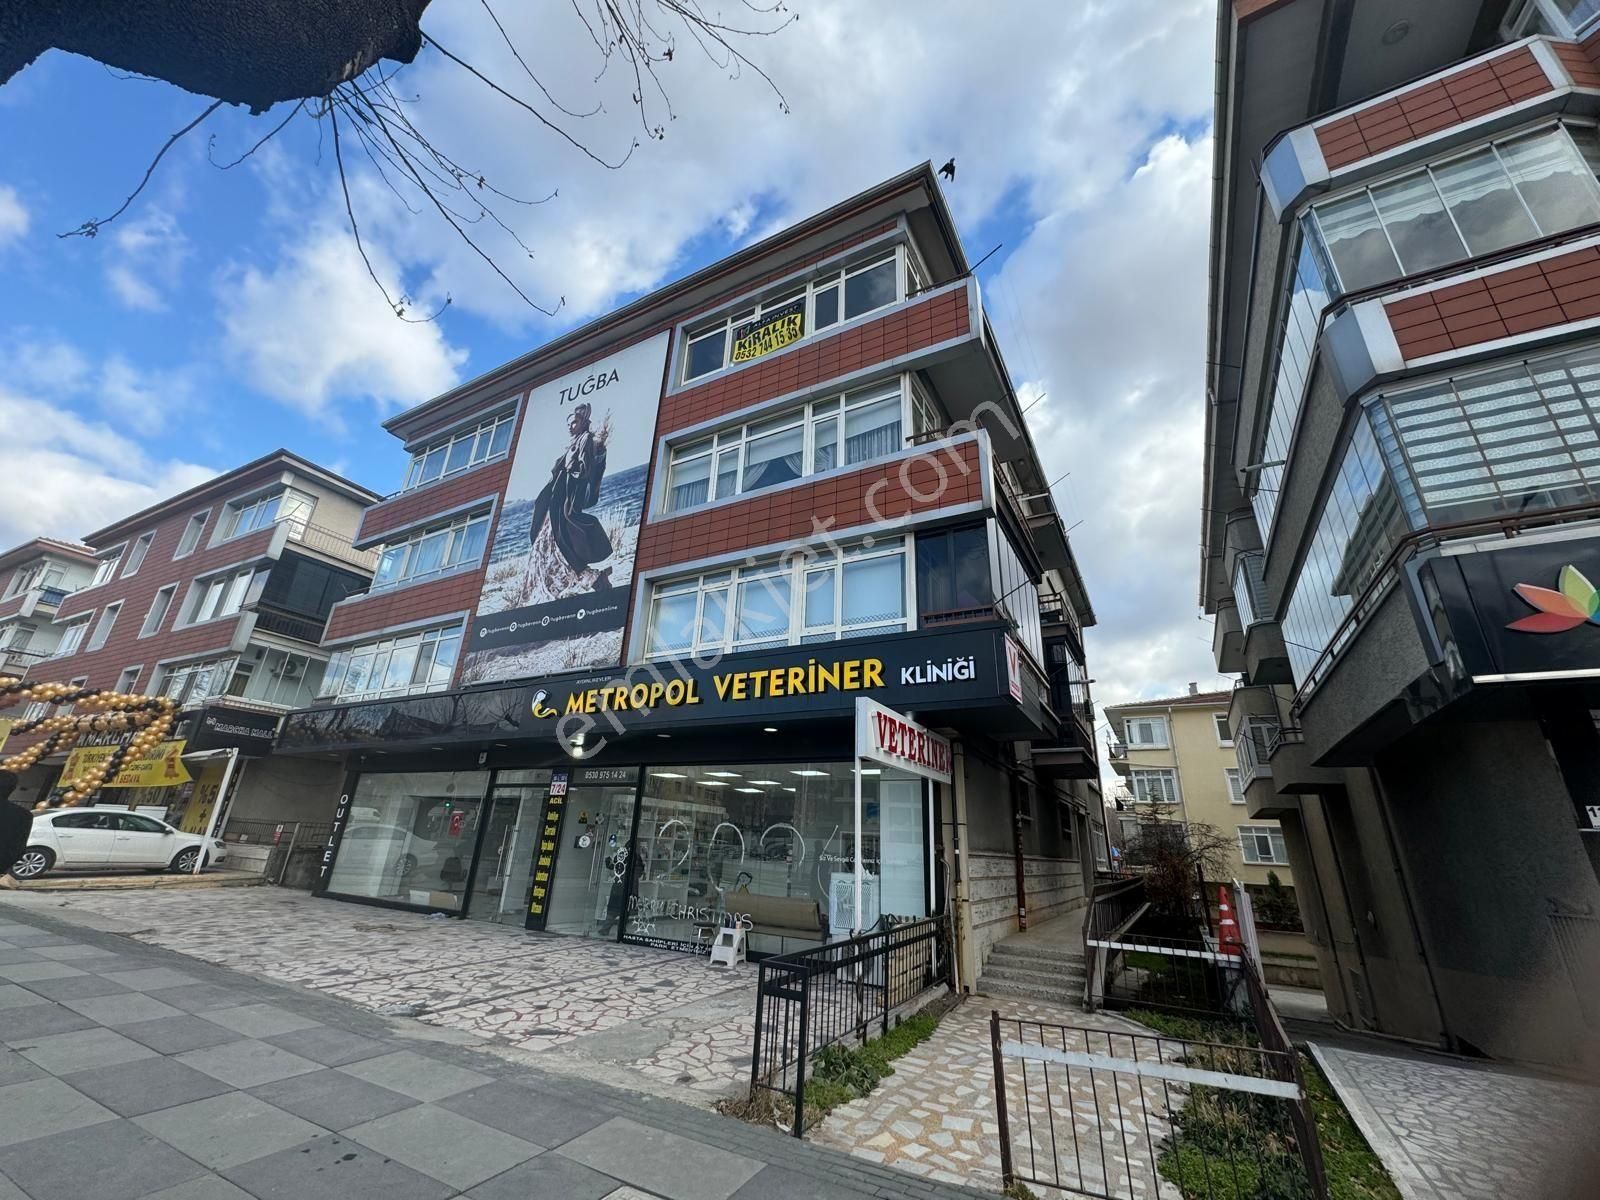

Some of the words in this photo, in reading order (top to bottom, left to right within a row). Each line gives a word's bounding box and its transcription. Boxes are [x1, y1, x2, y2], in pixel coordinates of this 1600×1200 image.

[735, 347, 757, 360] 0532
[759, 337, 773, 355] 744
[775, 331, 785, 346] 15
[559, 368, 619, 405] TUĞBA
[565, 678, 700, 715] METROPOL
[713, 658, 887, 701] VETERİNER
[901, 655, 976, 685] KLİNİĞİ
[585, 771, 599, 779] 0530
[599, 771, 610, 779] 975
[619, 770, 626, 778] 24
[551, 784, 566, 794] 7/24
[549, 796, 562, 805] ACİL
[320, 794, 349, 878] OUTLET
[623, 934, 644, 942] HASTA
[650, 942, 668, 950] PARK
